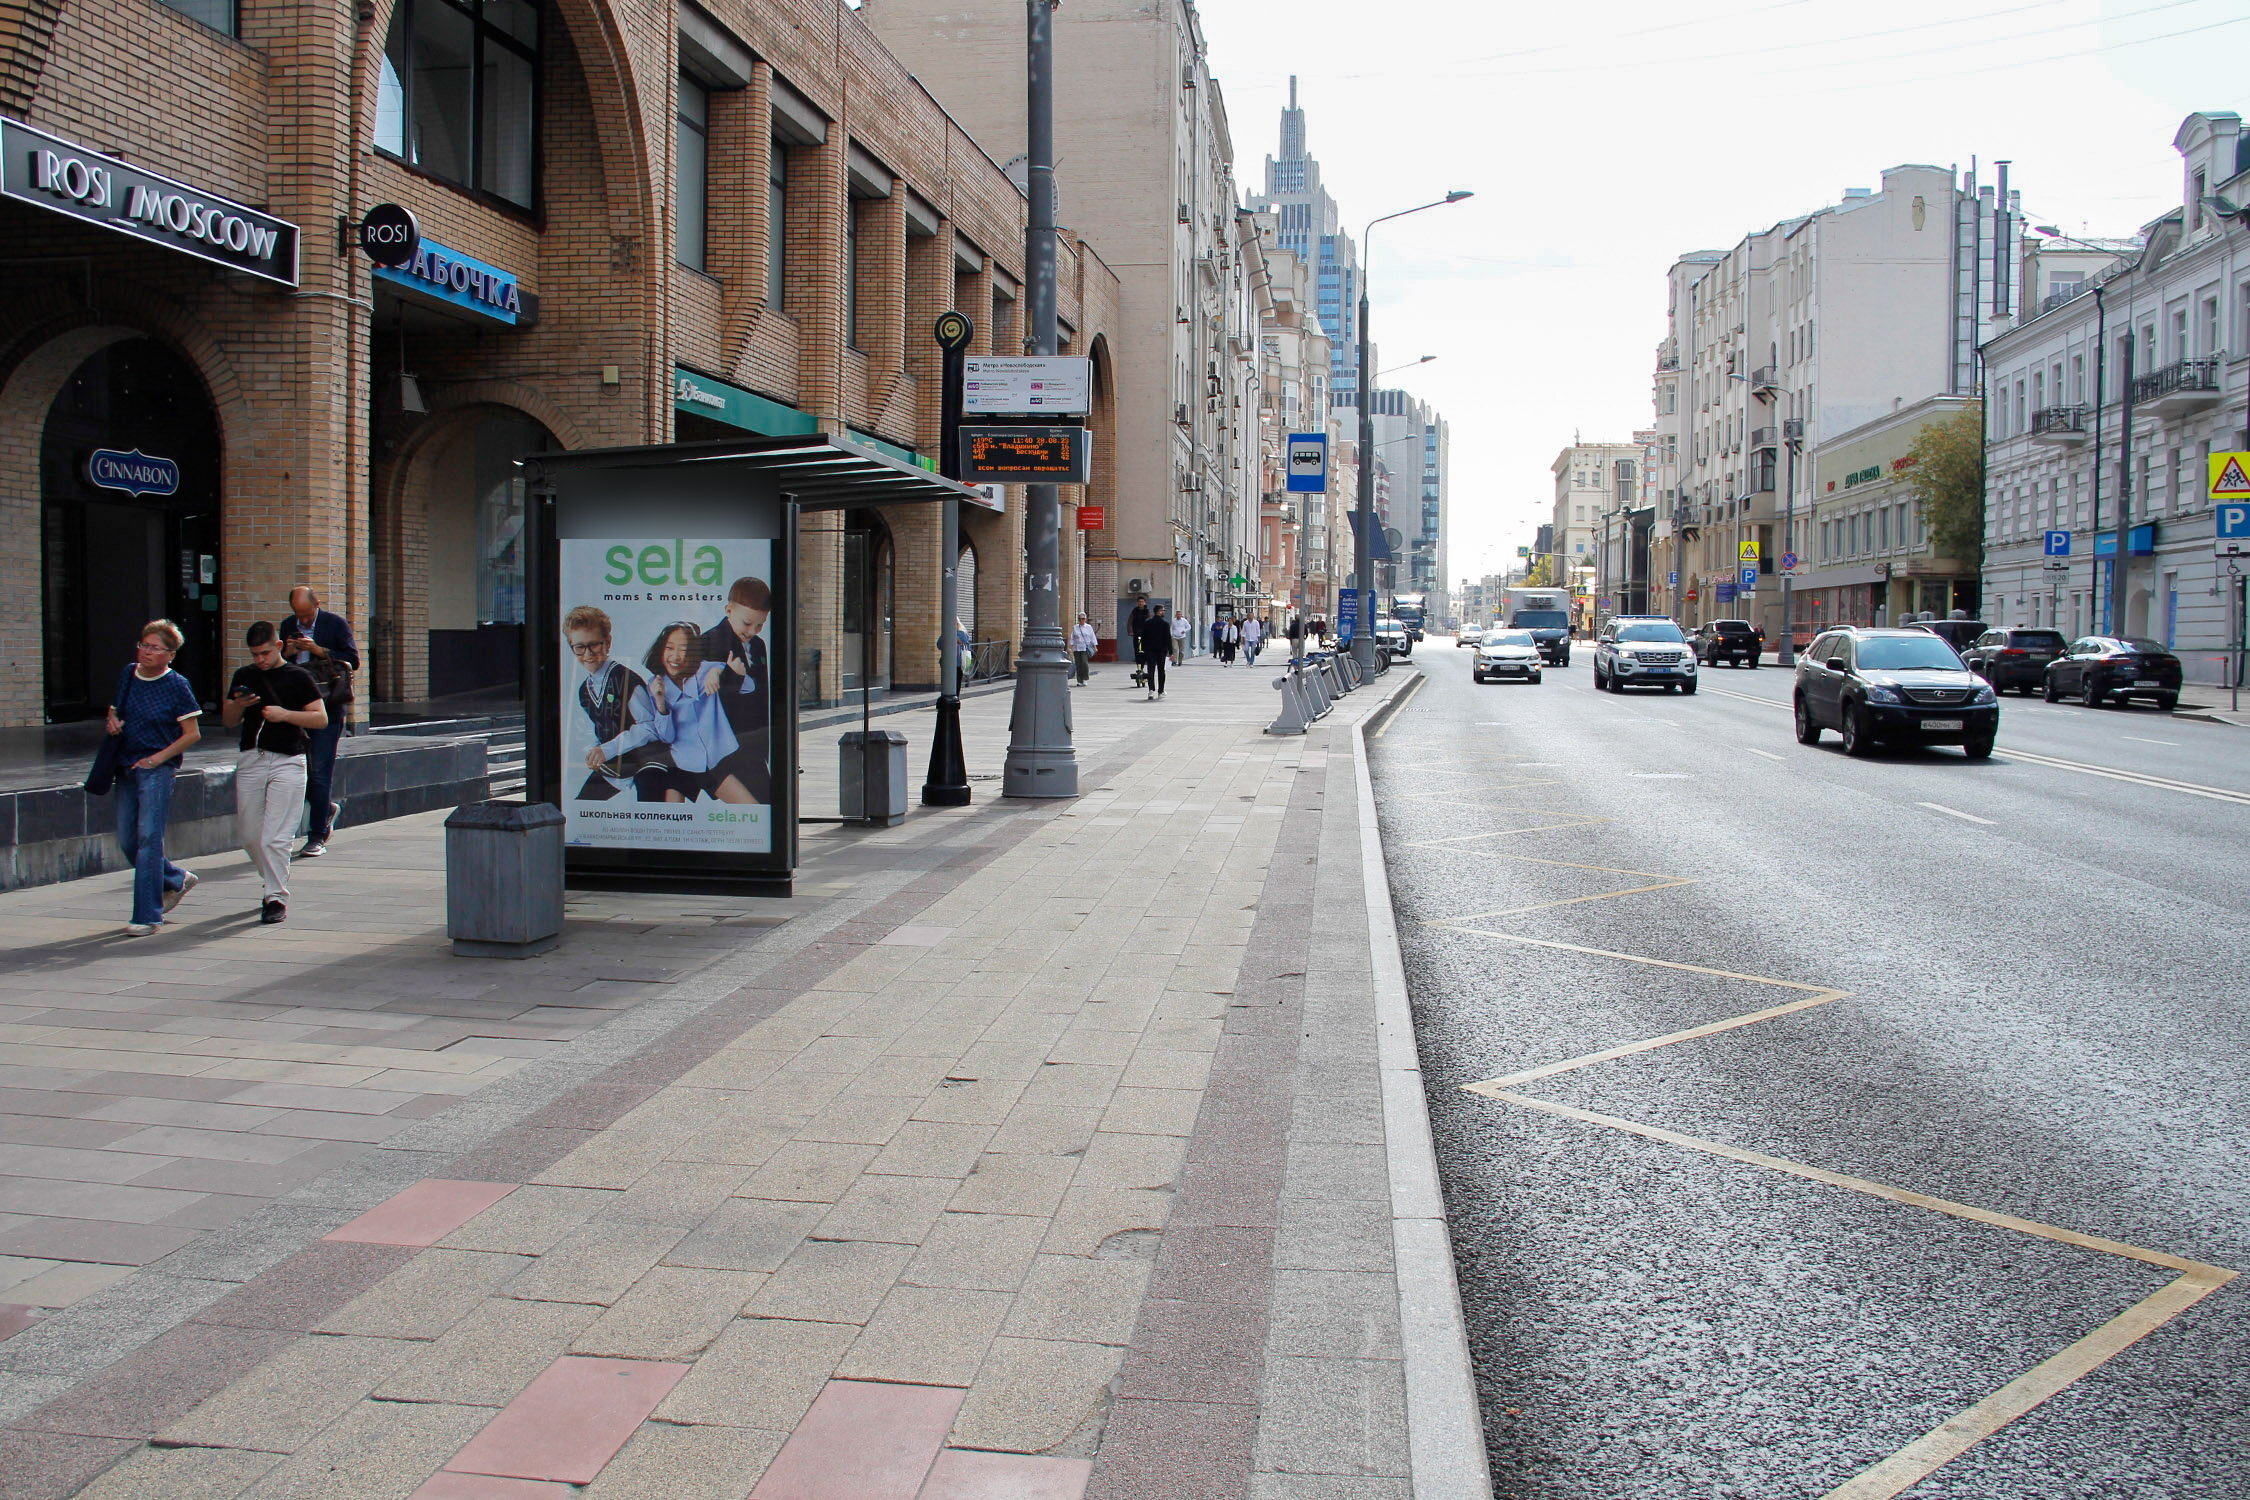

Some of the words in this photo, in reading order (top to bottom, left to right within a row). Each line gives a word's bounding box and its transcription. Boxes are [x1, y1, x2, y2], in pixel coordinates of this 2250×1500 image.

[367, 224, 408, 243] ROSI
[396, 247, 521, 313] АБОЧКА
[604, 538, 724, 587] sela
[604, 593, 640, 601] moms
[646, 592, 653, 601] &
[659, 592, 723, 602] monsters
[580, 810, 632, 820] школьная
[634, 812, 693, 822] коллекция
[707, 809, 758, 823] sela.ru
